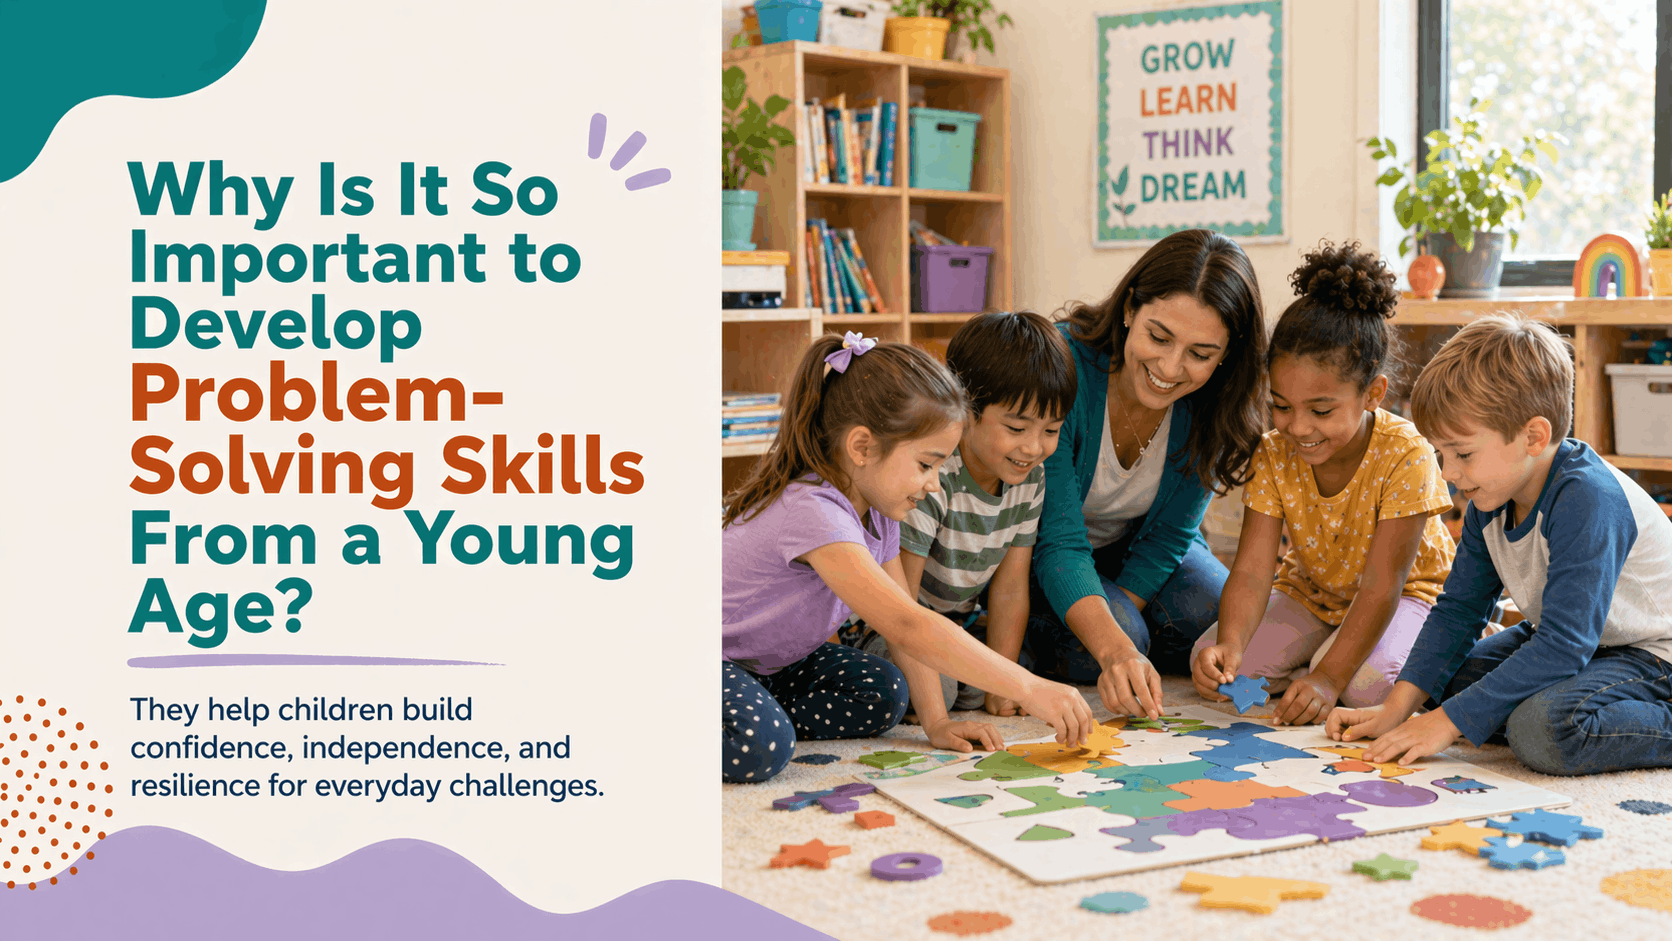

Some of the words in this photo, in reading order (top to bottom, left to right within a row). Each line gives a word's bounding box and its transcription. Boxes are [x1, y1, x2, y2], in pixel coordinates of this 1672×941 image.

[1141, 38, 1235, 74] GROW
[1141, 82, 1237, 117] LEARN
[1143, 126, 1234, 159] THINK
[1141, 169, 1246, 203] DREAM
